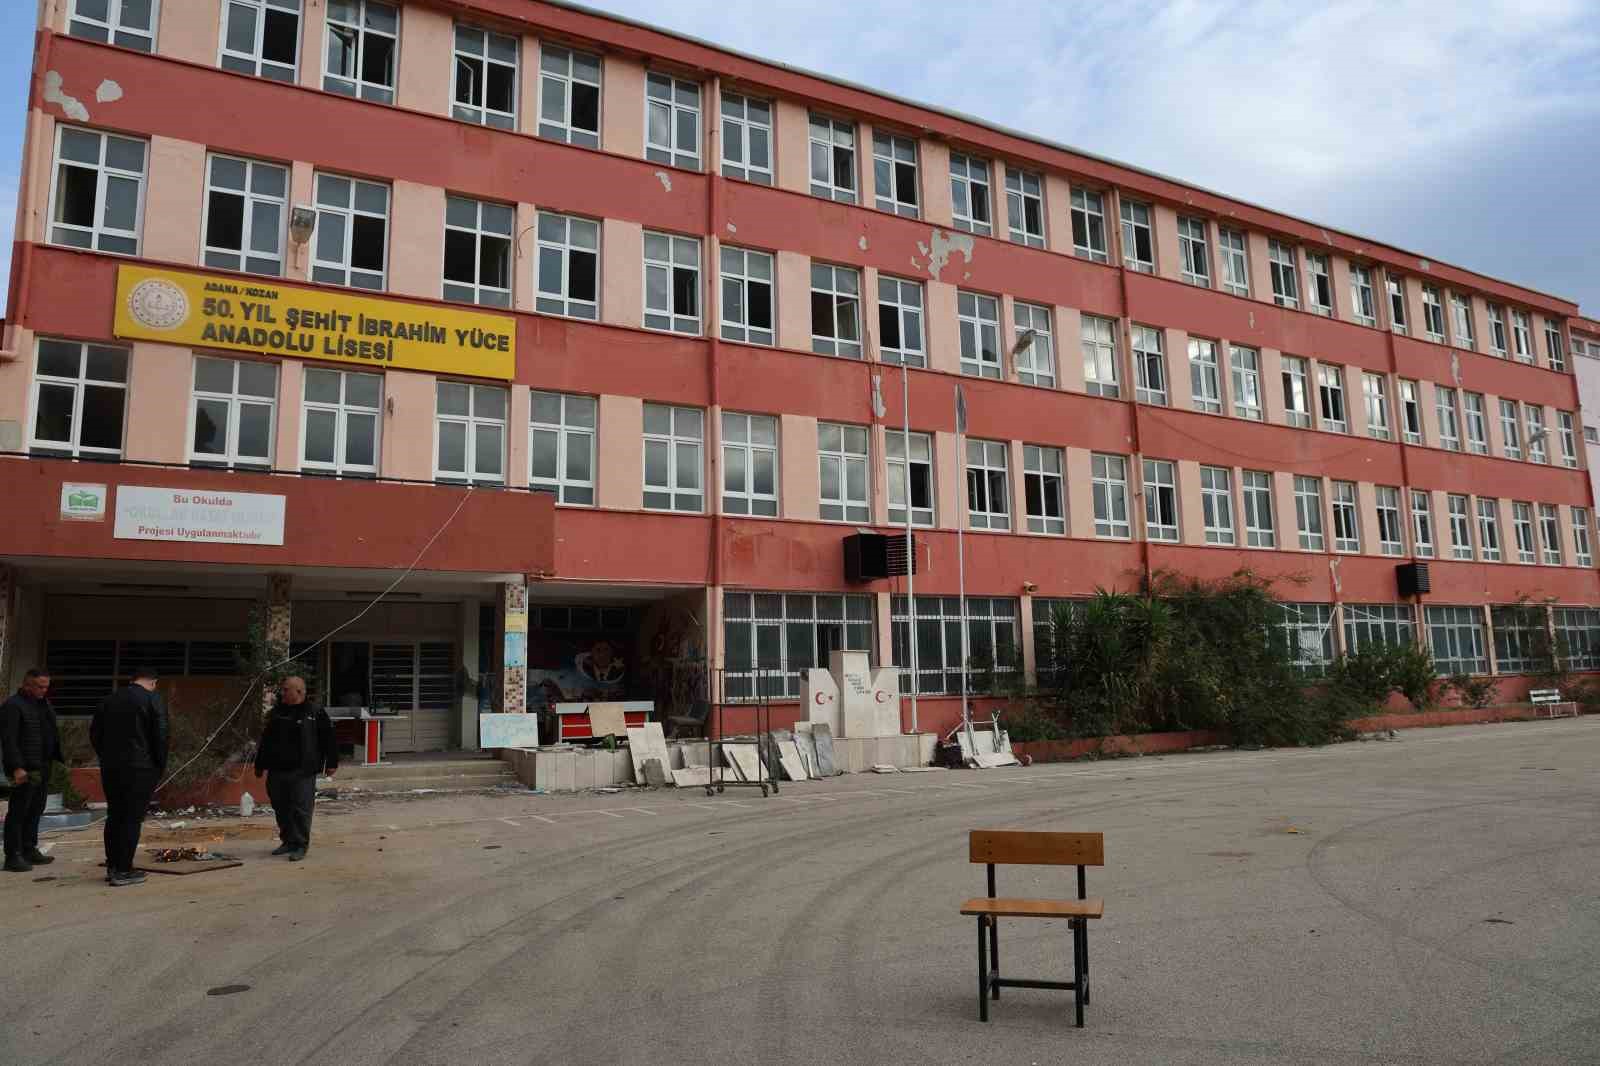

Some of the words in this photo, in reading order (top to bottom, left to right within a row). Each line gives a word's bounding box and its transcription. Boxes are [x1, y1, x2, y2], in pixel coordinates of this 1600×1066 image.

[203, 298, 234, 319] 50.
[240, 301, 277, 324] YIL
[286, 308, 353, 333] ŞEHİT
[358, 313, 447, 344] İBRAHİM
[455, 327, 510, 352] YÜCE
[202, 322, 315, 353] ANADOLU
[324, 334, 394, 361] LİSESİ
[174, 495, 189, 504] Bu
[192, 496, 233, 506] Okulda
[138, 525, 174, 538] Projesi
